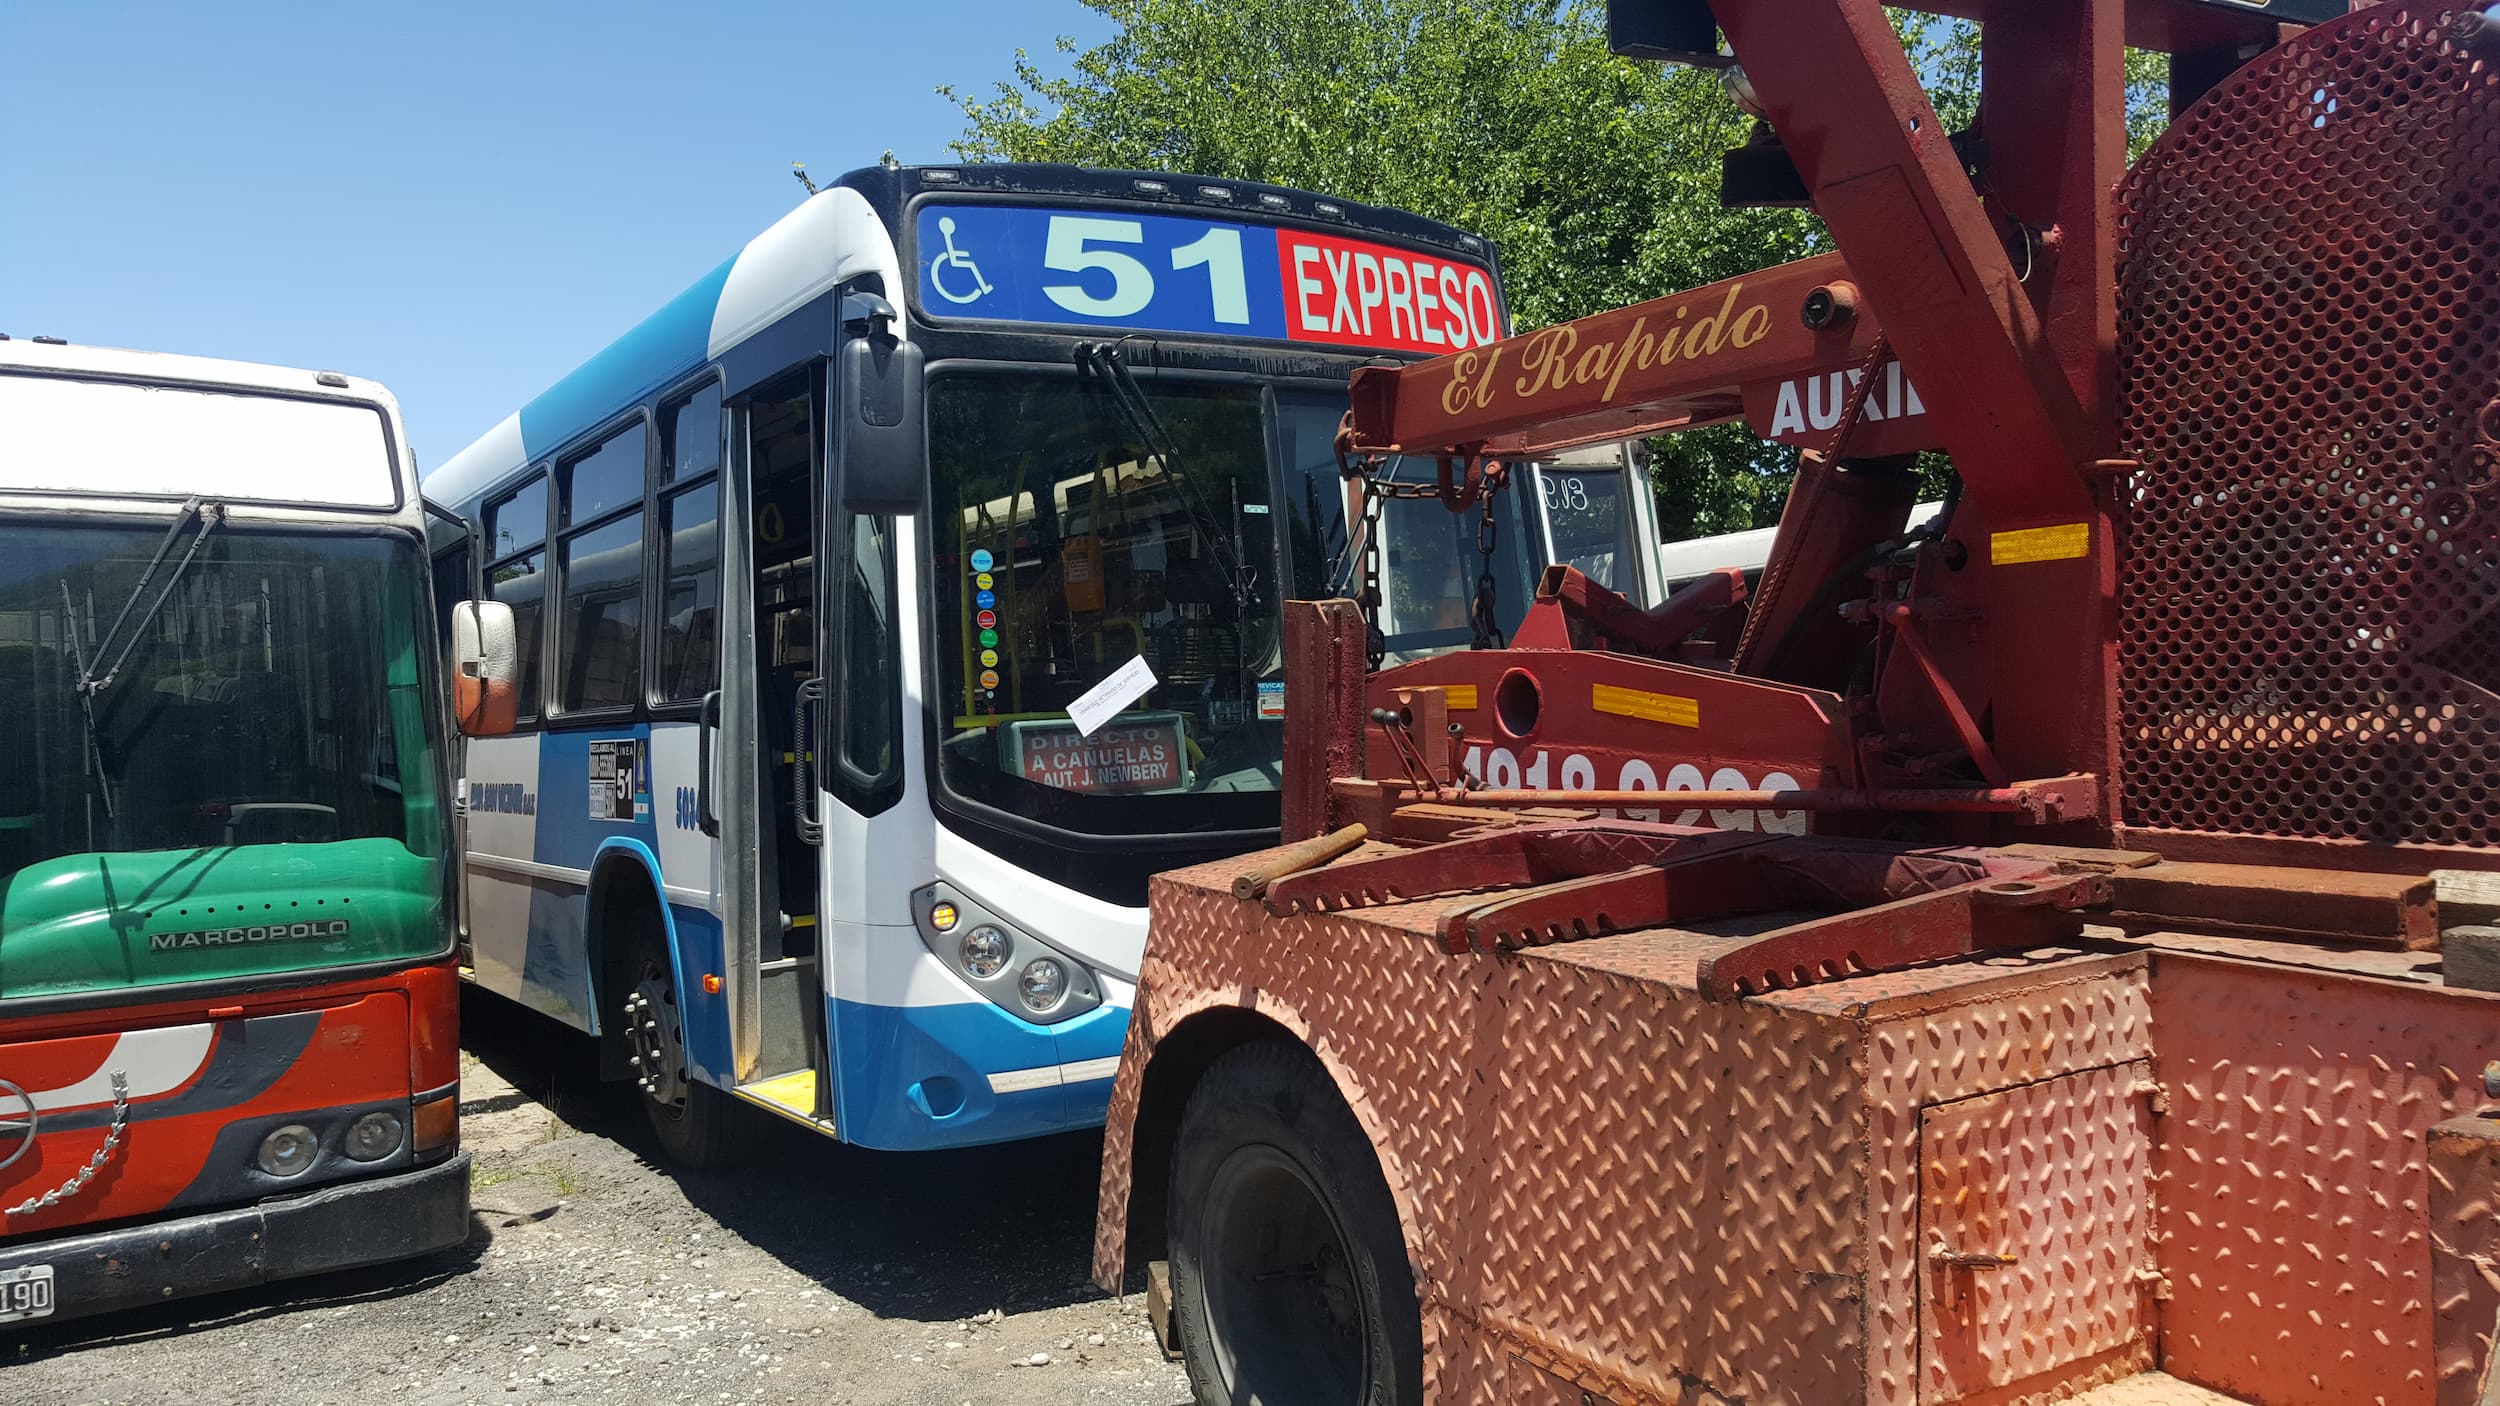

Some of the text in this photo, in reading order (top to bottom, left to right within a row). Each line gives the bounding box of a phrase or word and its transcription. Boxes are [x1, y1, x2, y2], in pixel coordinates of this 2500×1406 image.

[1042, 215, 1251, 326] 51
[1293, 244, 1495, 350] EXPRESO
[1441, 282, 1774, 416] El Rapido
[1031, 728, 1161, 750] DIRECTO
[1032, 755, 1046, 772] A
[1044, 762, 1169, 788] AUT. J. NEWBERY
[617, 768, 633, 800] 51
[676, 786, 701, 831] 508
[151, 920, 348, 950] MARCOPOLO
